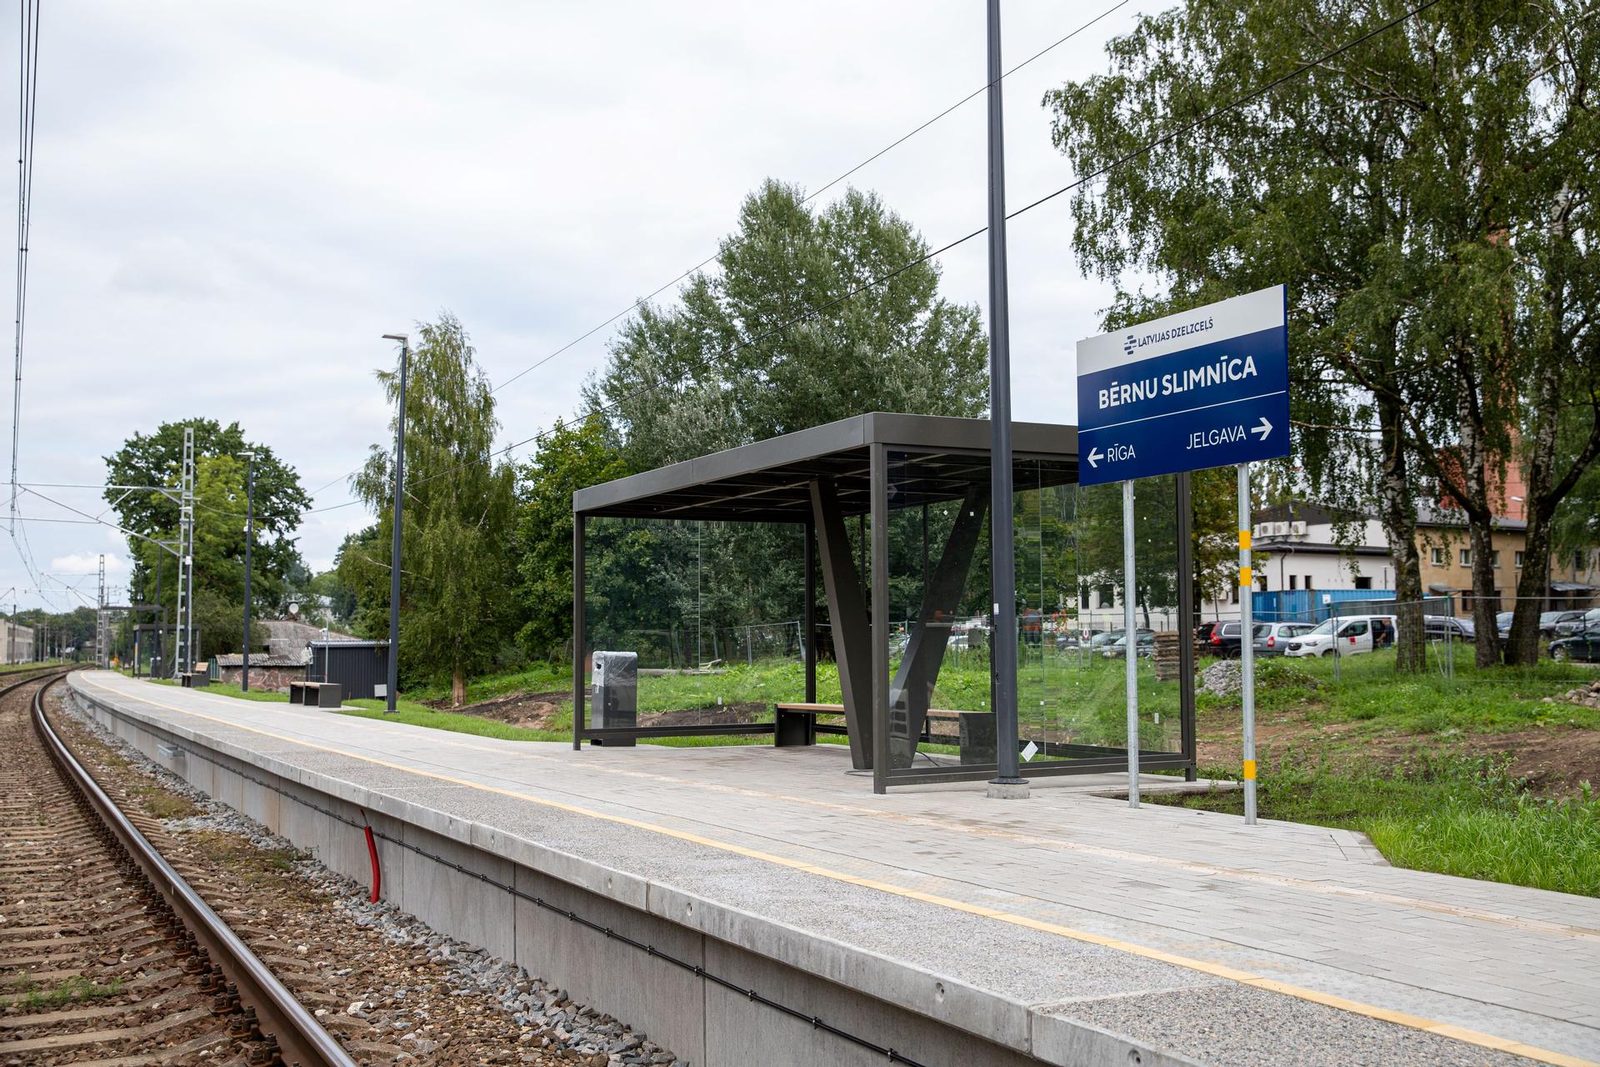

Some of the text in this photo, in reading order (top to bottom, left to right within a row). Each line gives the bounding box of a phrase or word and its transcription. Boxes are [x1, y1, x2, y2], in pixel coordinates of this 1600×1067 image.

[1138, 331, 1171, 347] LATVIJAS
[1099, 356, 1257, 409] BĒRNU SLIMNĪCA
[1186, 425, 1246, 450] JELGAVA
[1107, 443, 1136, 463] RĪGA
